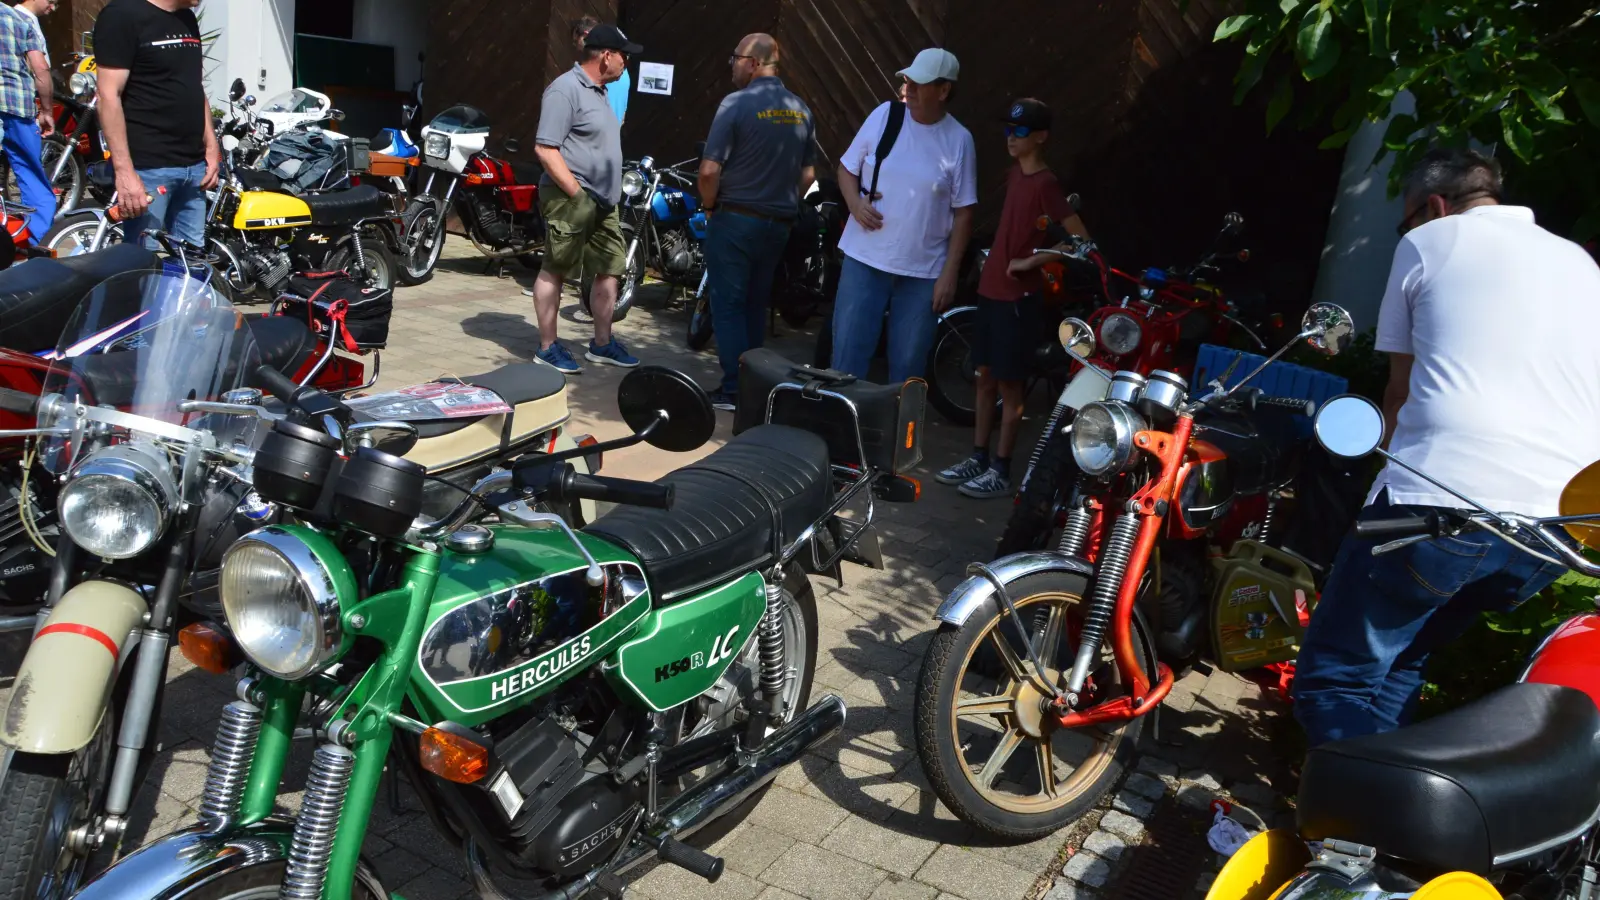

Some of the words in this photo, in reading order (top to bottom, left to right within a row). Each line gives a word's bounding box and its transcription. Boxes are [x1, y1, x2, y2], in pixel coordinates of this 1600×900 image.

[264, 217, 286, 226] DKW
[3, 563, 35, 575] SACHS
[706, 624, 740, 668] LC
[491, 635, 591, 701] HERCULES
[571, 823, 616, 858] SACHS
